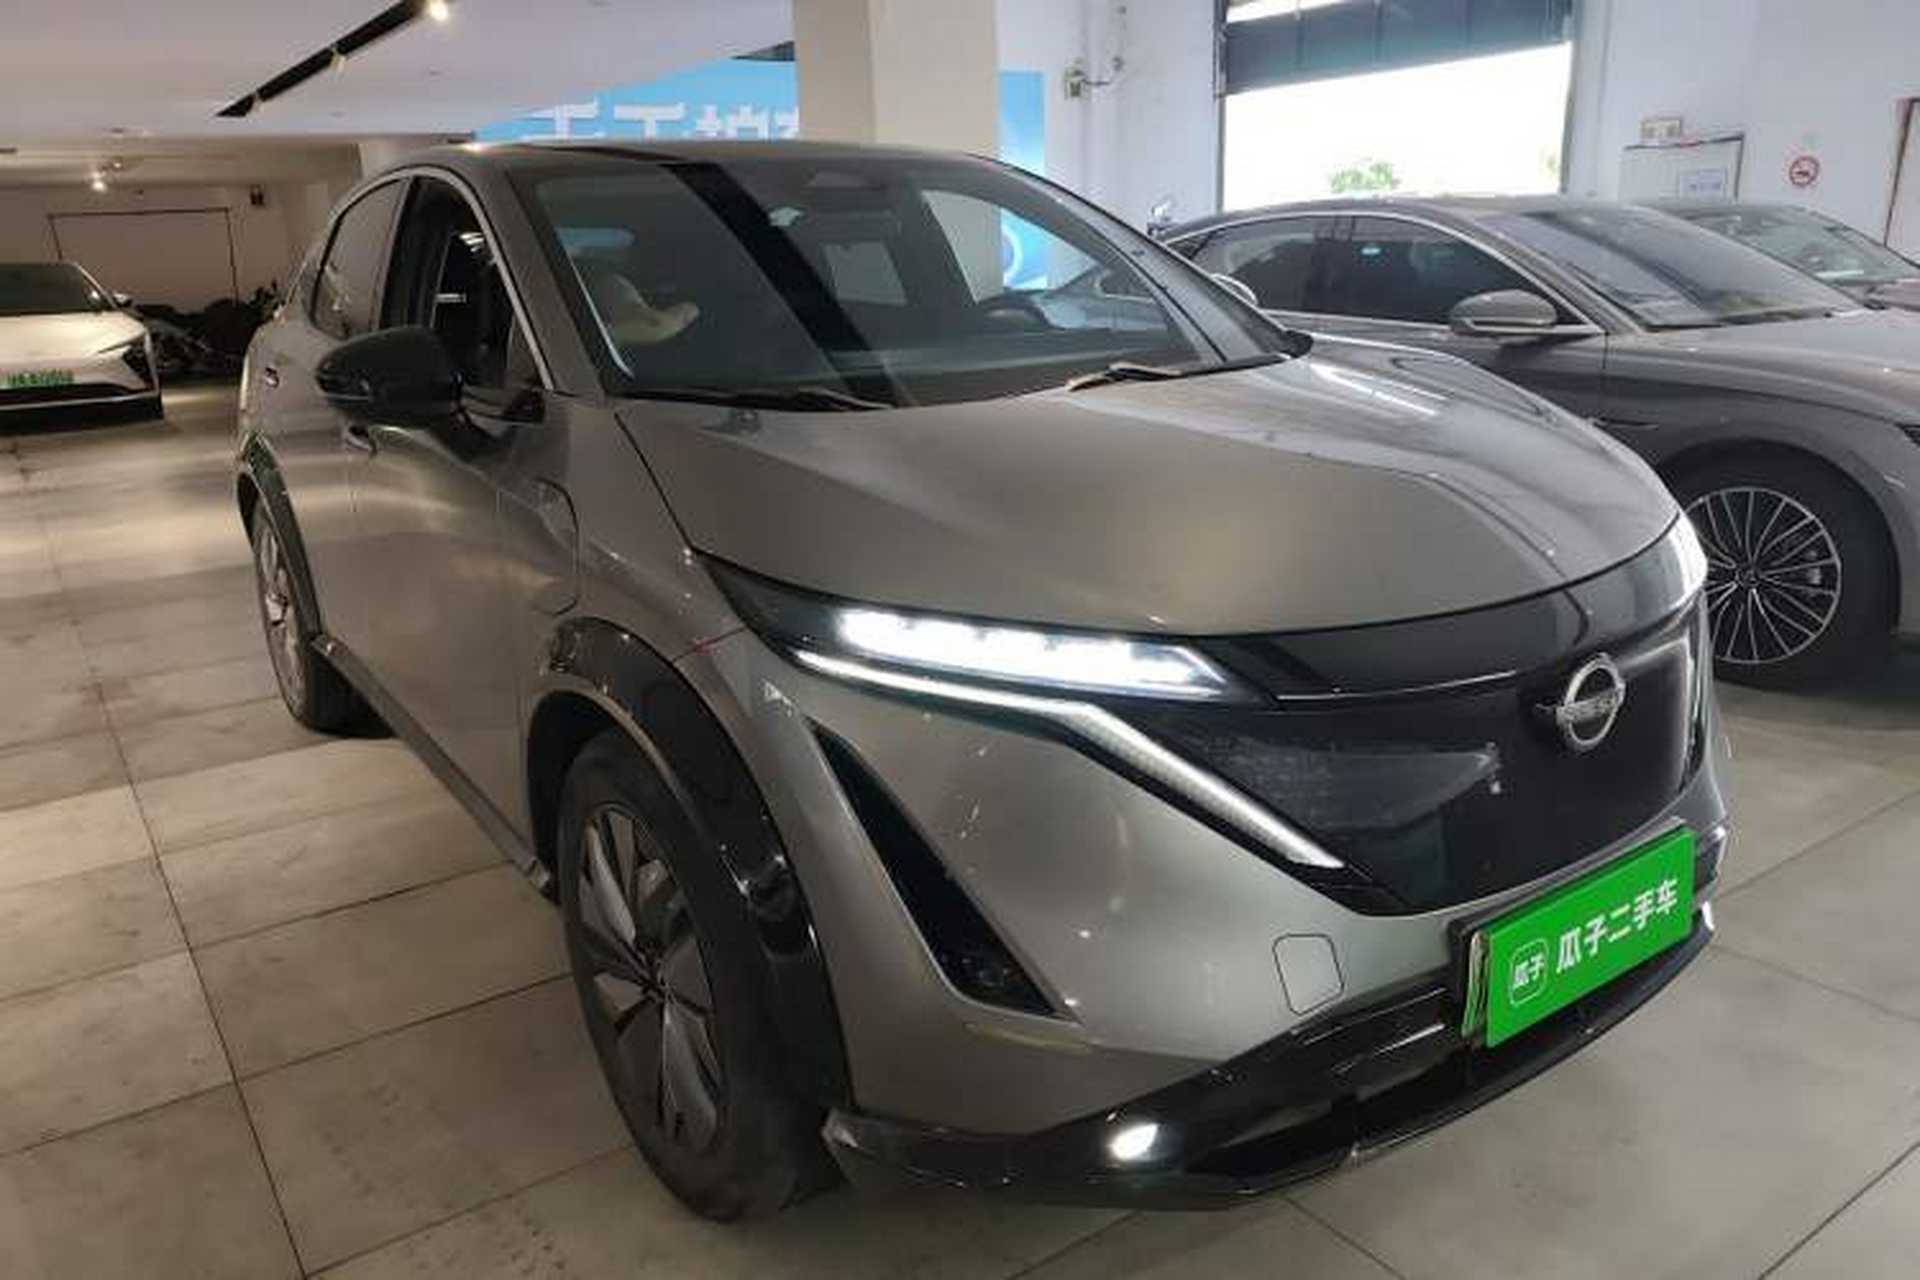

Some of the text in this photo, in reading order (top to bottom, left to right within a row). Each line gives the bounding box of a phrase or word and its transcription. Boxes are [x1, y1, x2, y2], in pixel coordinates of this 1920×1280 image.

[1556, 878, 1678, 974] 瓜子二手车
[1513, 954, 1546, 988] 瓜子
